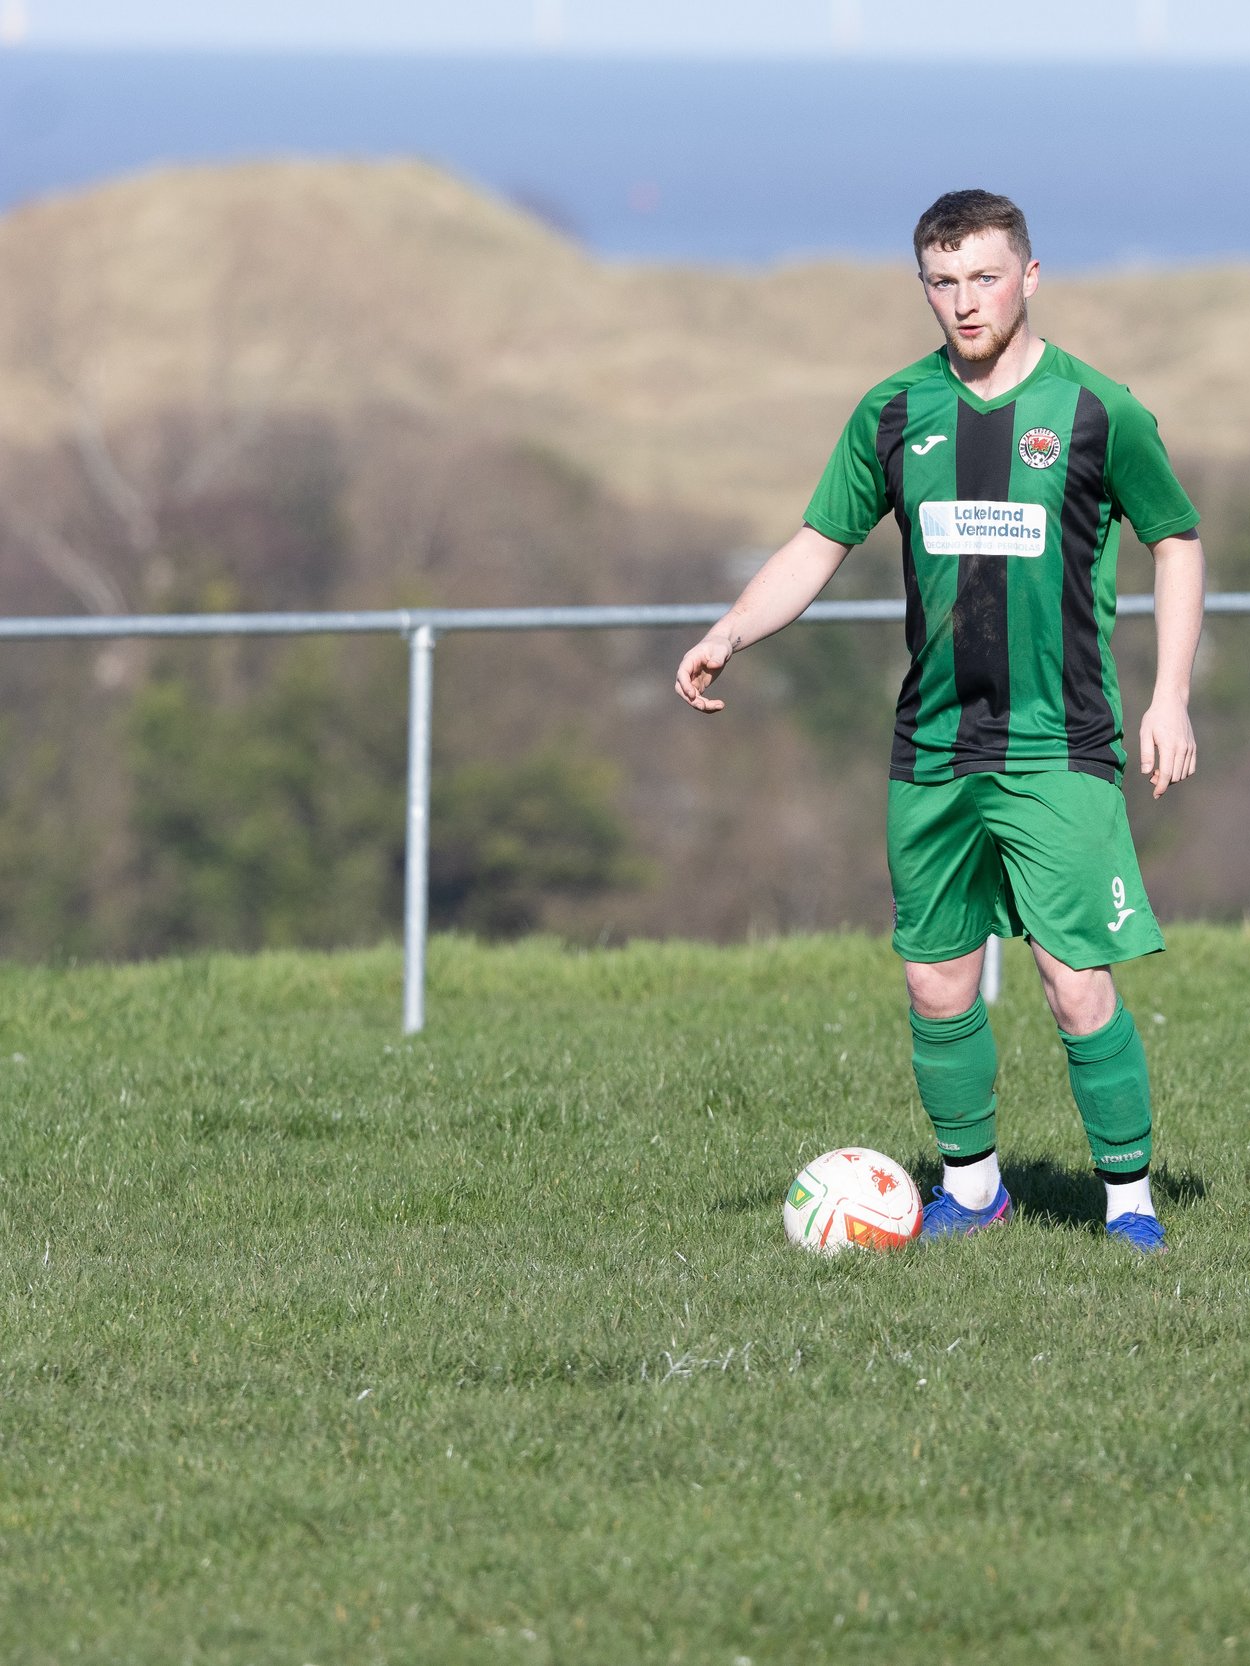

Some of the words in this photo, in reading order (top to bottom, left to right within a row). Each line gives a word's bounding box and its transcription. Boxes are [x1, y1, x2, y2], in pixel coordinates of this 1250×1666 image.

[954, 506, 1024, 522] Lakeland
[955, 523, 1041, 539] Verandahs
[1112, 876, 1126, 909] 9
